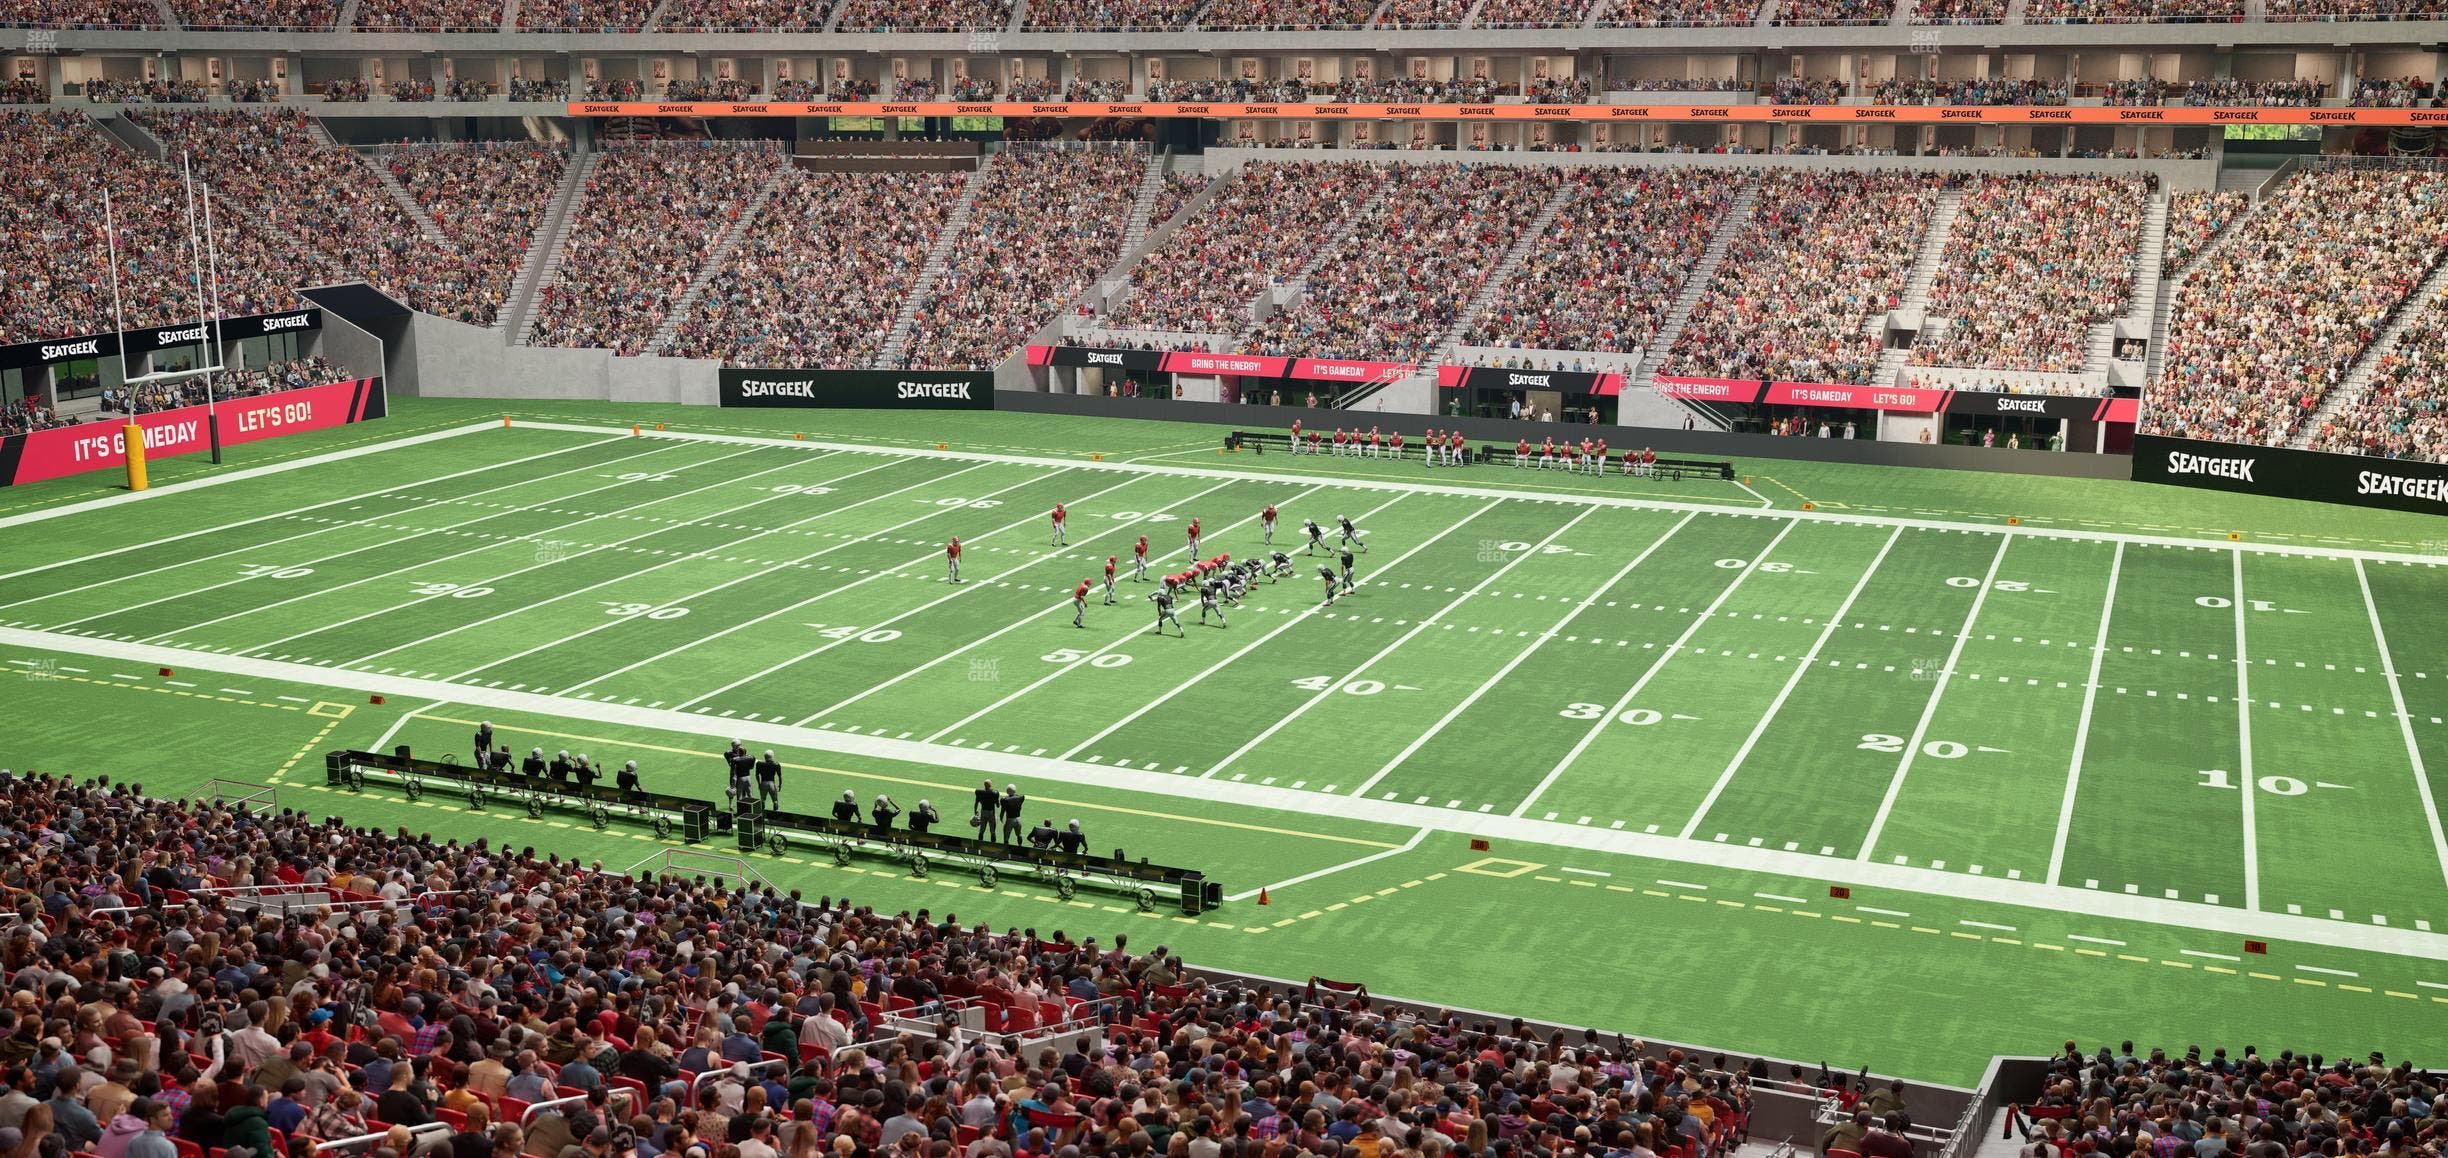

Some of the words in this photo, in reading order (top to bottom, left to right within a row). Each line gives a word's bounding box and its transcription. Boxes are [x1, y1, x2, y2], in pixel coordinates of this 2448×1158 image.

[584, 105, 620, 113] SEATGEEK
[658, 105, 694, 113] SEATGEEK
[732, 105, 768, 113] SEATGEEK
[807, 105, 842, 113] SEATGEEK
[881, 105, 918, 113] SEATGEEK
[957, 105, 993, 114] SEATGEEK
[1032, 105, 1069, 114] SEATGEEK
[1108, 105, 1142, 114] SEATGEEK
[1177, 105, 1210, 114] SEATGEEK
[1245, 106, 1278, 115] SEATGEEK
[1315, 106, 1349, 115] SEATGEEK
[1386, 106, 1421, 115] SEATGEEK
[1459, 107, 1495, 116] SEATGEEK
[1534, 107, 1571, 116] SEATGEEK
[1611, 107, 1649, 117] SEATGEEK
[1690, 108, 1729, 117] SEATGEEK
[1772, 108, 1811, 118] SEATGEEK
[1855, 109, 1896, 118] SEATGEEK
[1941, 109, 1983, 119] SEATGEEK
[2029, 110, 2072, 120] SEATGEEK
[2120, 110, 2164, 120] SEATGEEK
[2213, 110, 2259, 121] SEATGEEK
[2309, 111, 2356, 121] SEATGEEK
[263, 314, 310, 332] SEATGEEK
[158, 326, 209, 345] SEATGEEK
[41, 339, 99, 360] SEATGEEK
[1088, 352, 1123, 365] SEATGEEK
[1192, 359, 1213, 368] BRING
[1216, 360, 1228, 369] THE
[1231, 361, 1260, 370] ENERGY!
[1313, 365, 1328, 375] IT'S
[1329, 366, 1366, 377] GAMEDAY
[1509, 373, 1550, 387] SEATGEEK
[742, 380, 814, 398] SEATGEEK
[898, 382, 971, 399] SEATGEEK
[1693, 385, 1730, 396] ENERGY!
[1791, 388, 1807, 399] IT'S
[1810, 389, 1852, 402] GAMEDAY
[1873, 392, 1898, 404] LET'S
[1900, 394, 1916, 405] GO!
[1998, 397, 2046, 414] SEATGEEK
[237, 404, 282, 433] LET'S
[284, 400, 312, 422] GO!
[74, 435, 110, 462] IT'S
[113, 420, 198, 455] GMEDAY
[2168, 451, 2255, 482] SEATGEEK
[605, 603, 691, 620] 30
[820, 627, 902, 643] 40
[1041, 648, 1132, 669] 50
[1291, 675, 1386, 696] 40
[1559, 703, 1664, 726] 30
[1857, 733, 1968, 760] 20
[2198, 770, 2309, 796] 10
